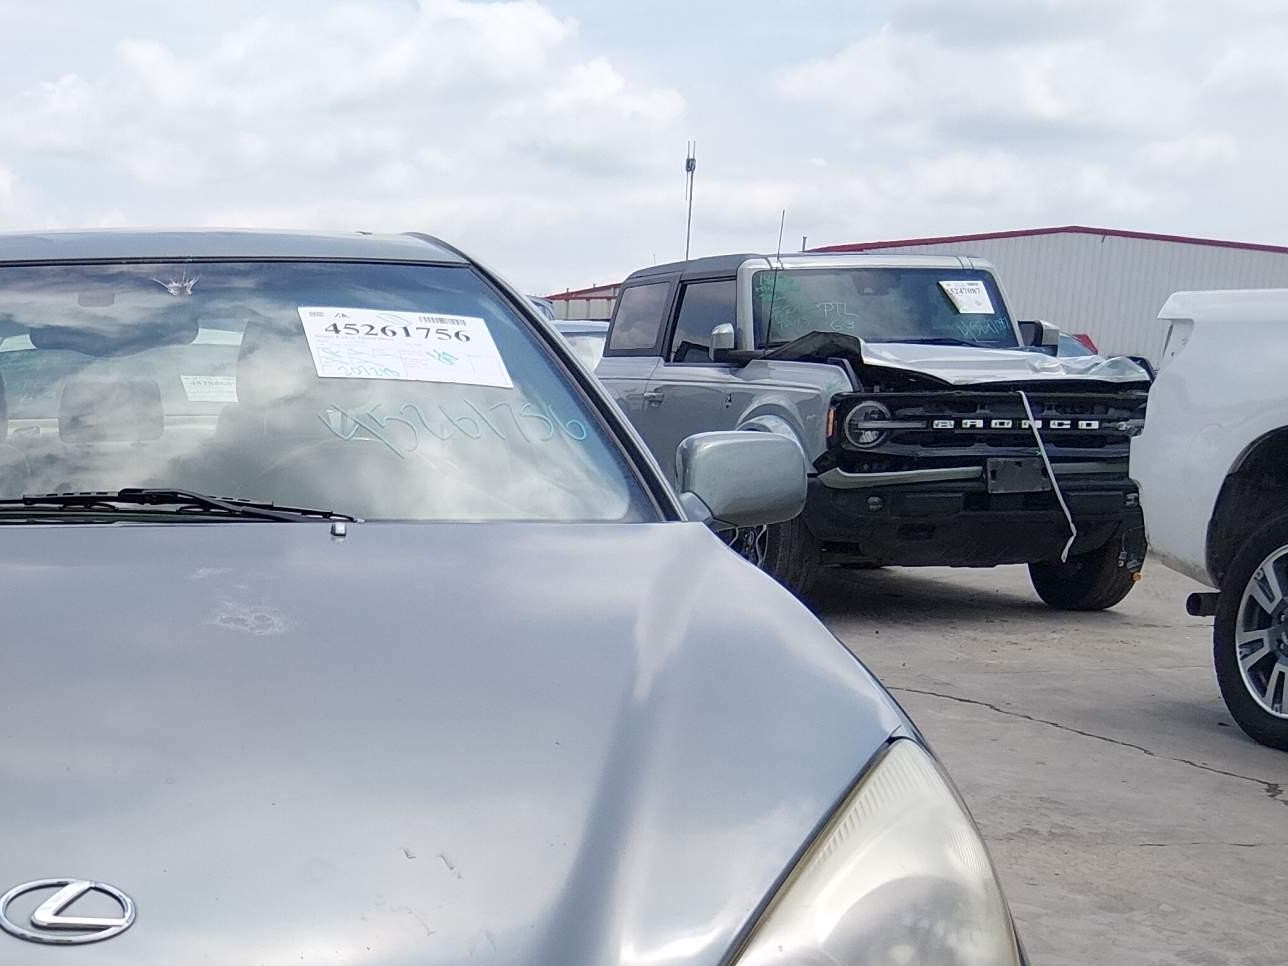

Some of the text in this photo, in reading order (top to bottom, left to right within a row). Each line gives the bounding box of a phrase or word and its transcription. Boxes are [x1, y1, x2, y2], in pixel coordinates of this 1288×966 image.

[324, 322, 471, 342] 45261756
[318, 399, 587, 459] 45261756
[933, 419, 1099, 430] BRONCO
